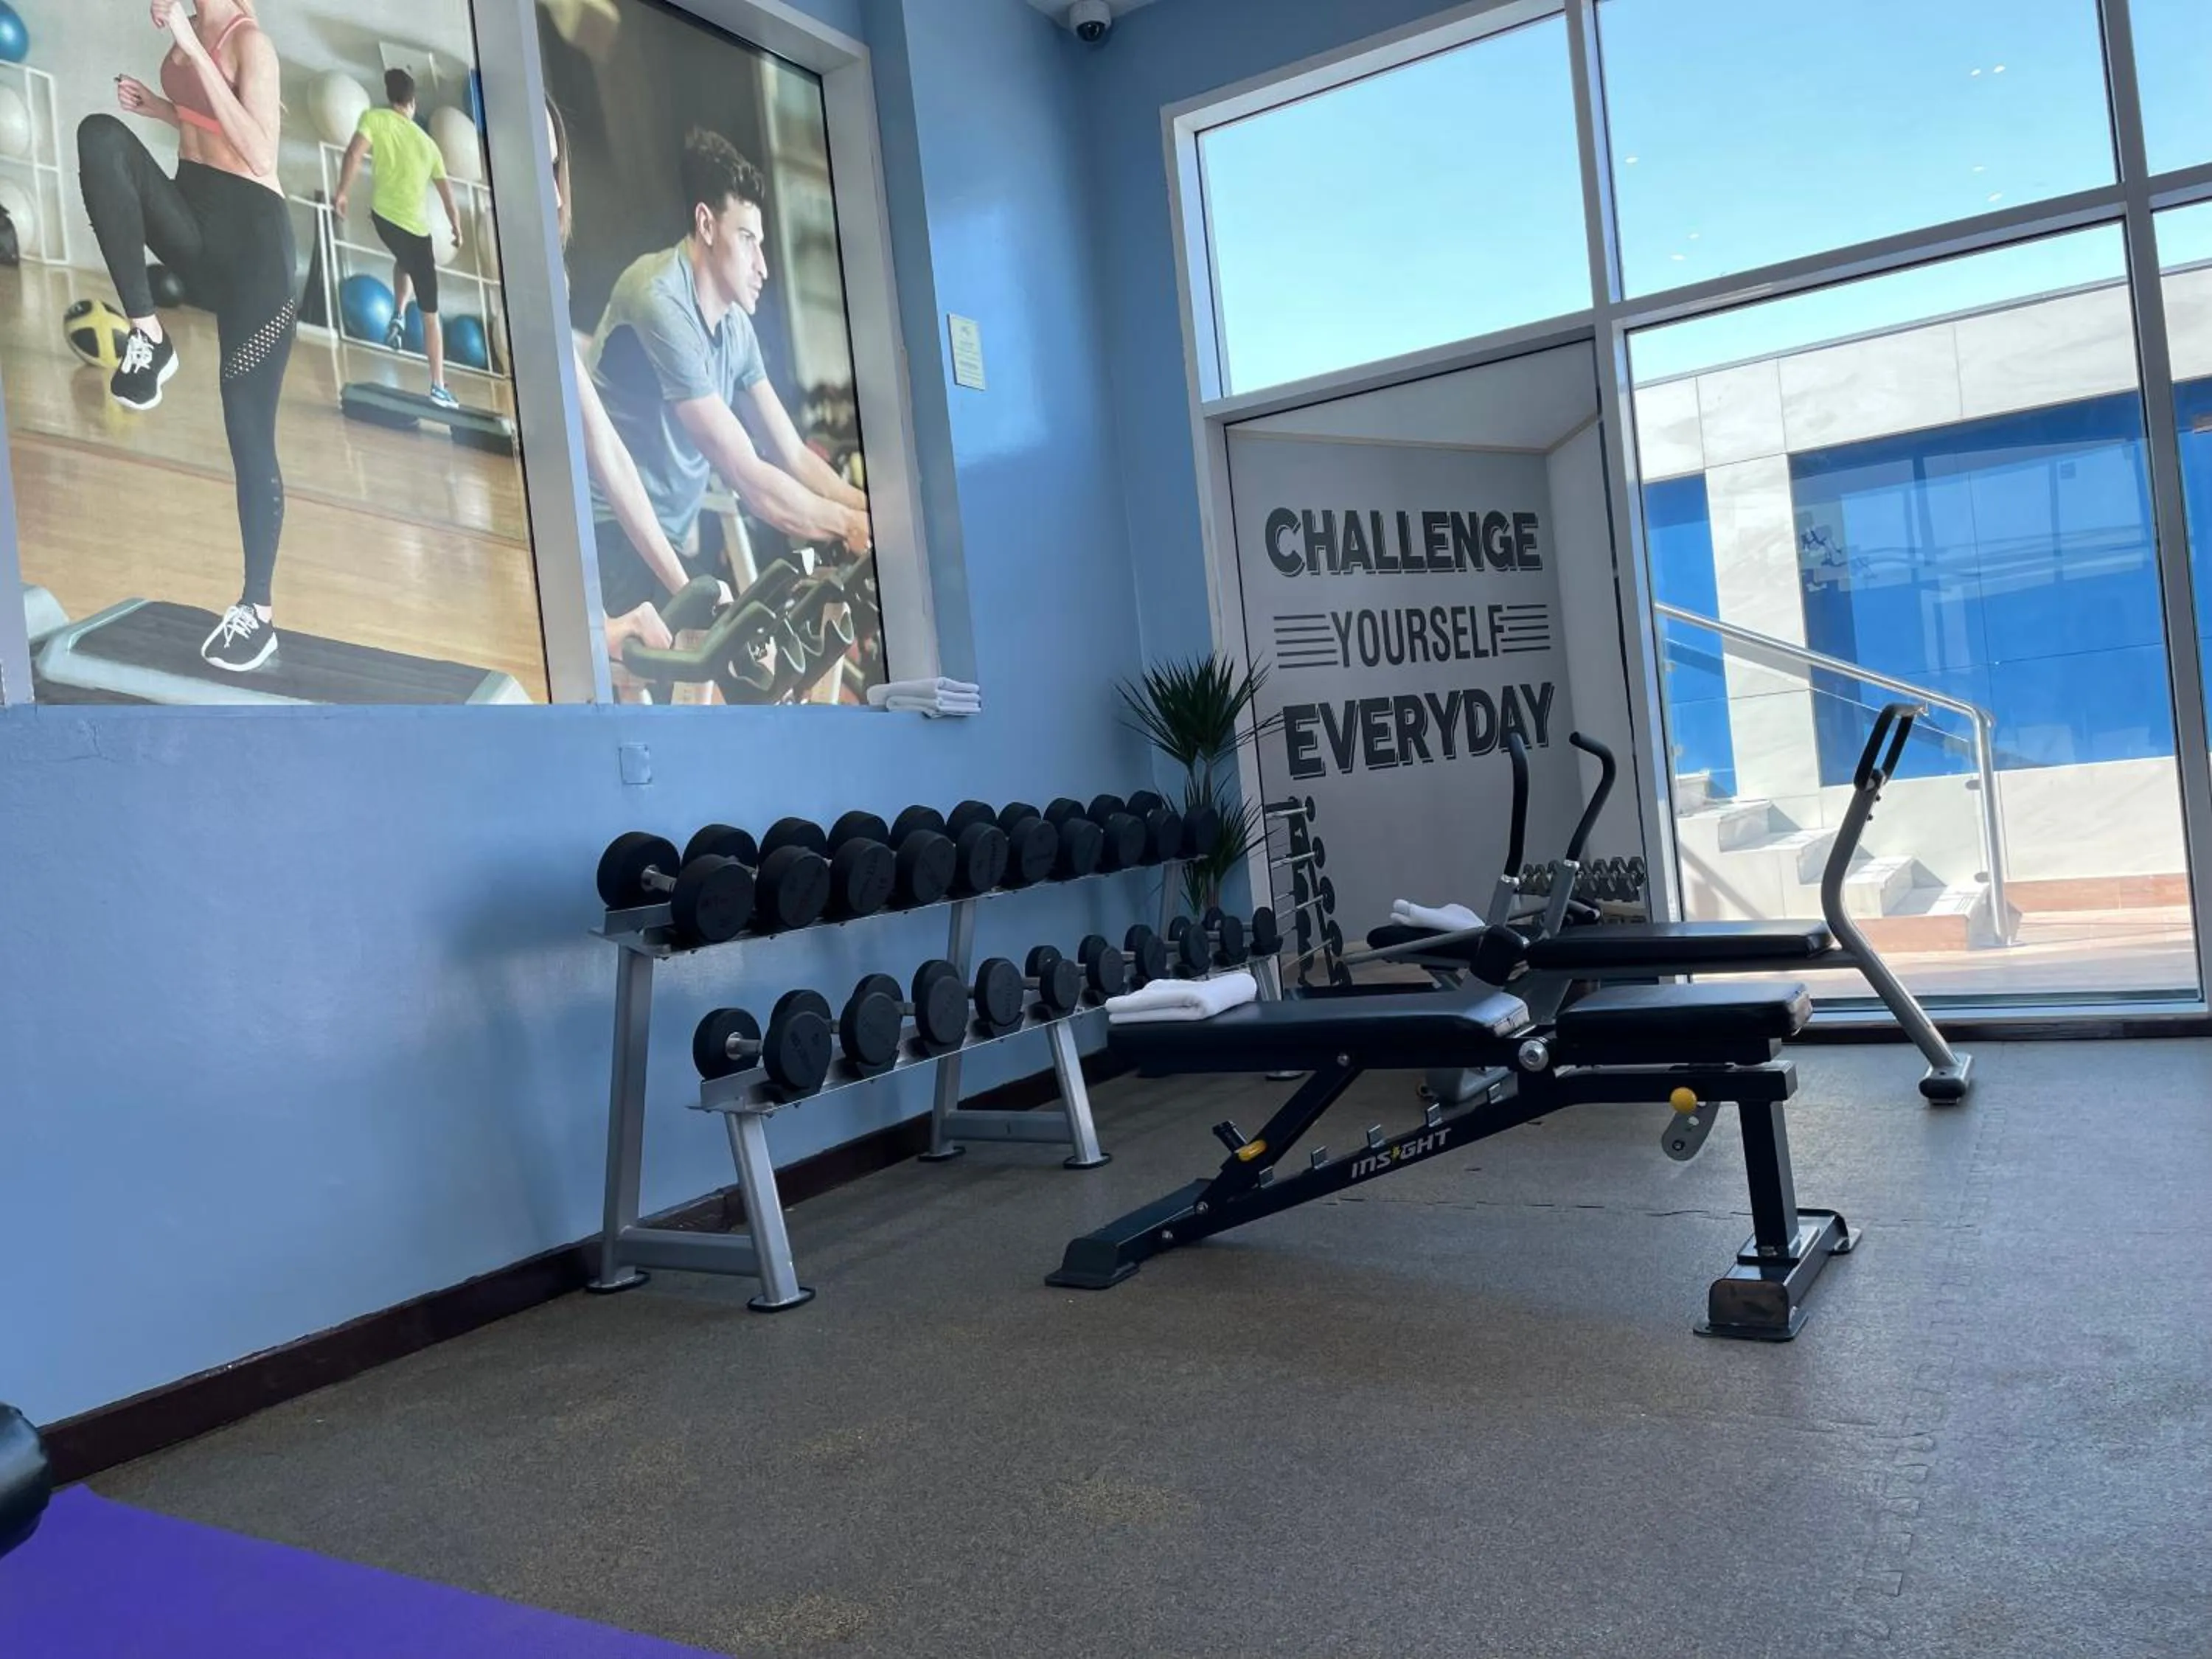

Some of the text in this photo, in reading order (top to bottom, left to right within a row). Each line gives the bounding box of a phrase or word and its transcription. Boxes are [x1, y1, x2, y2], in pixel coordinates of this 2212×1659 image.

[1265, 507, 1543, 577] CHALLENGE
[1330, 605, 1505, 668] YOURSELF
[1283, 682, 1554, 779] EVERYDAY
